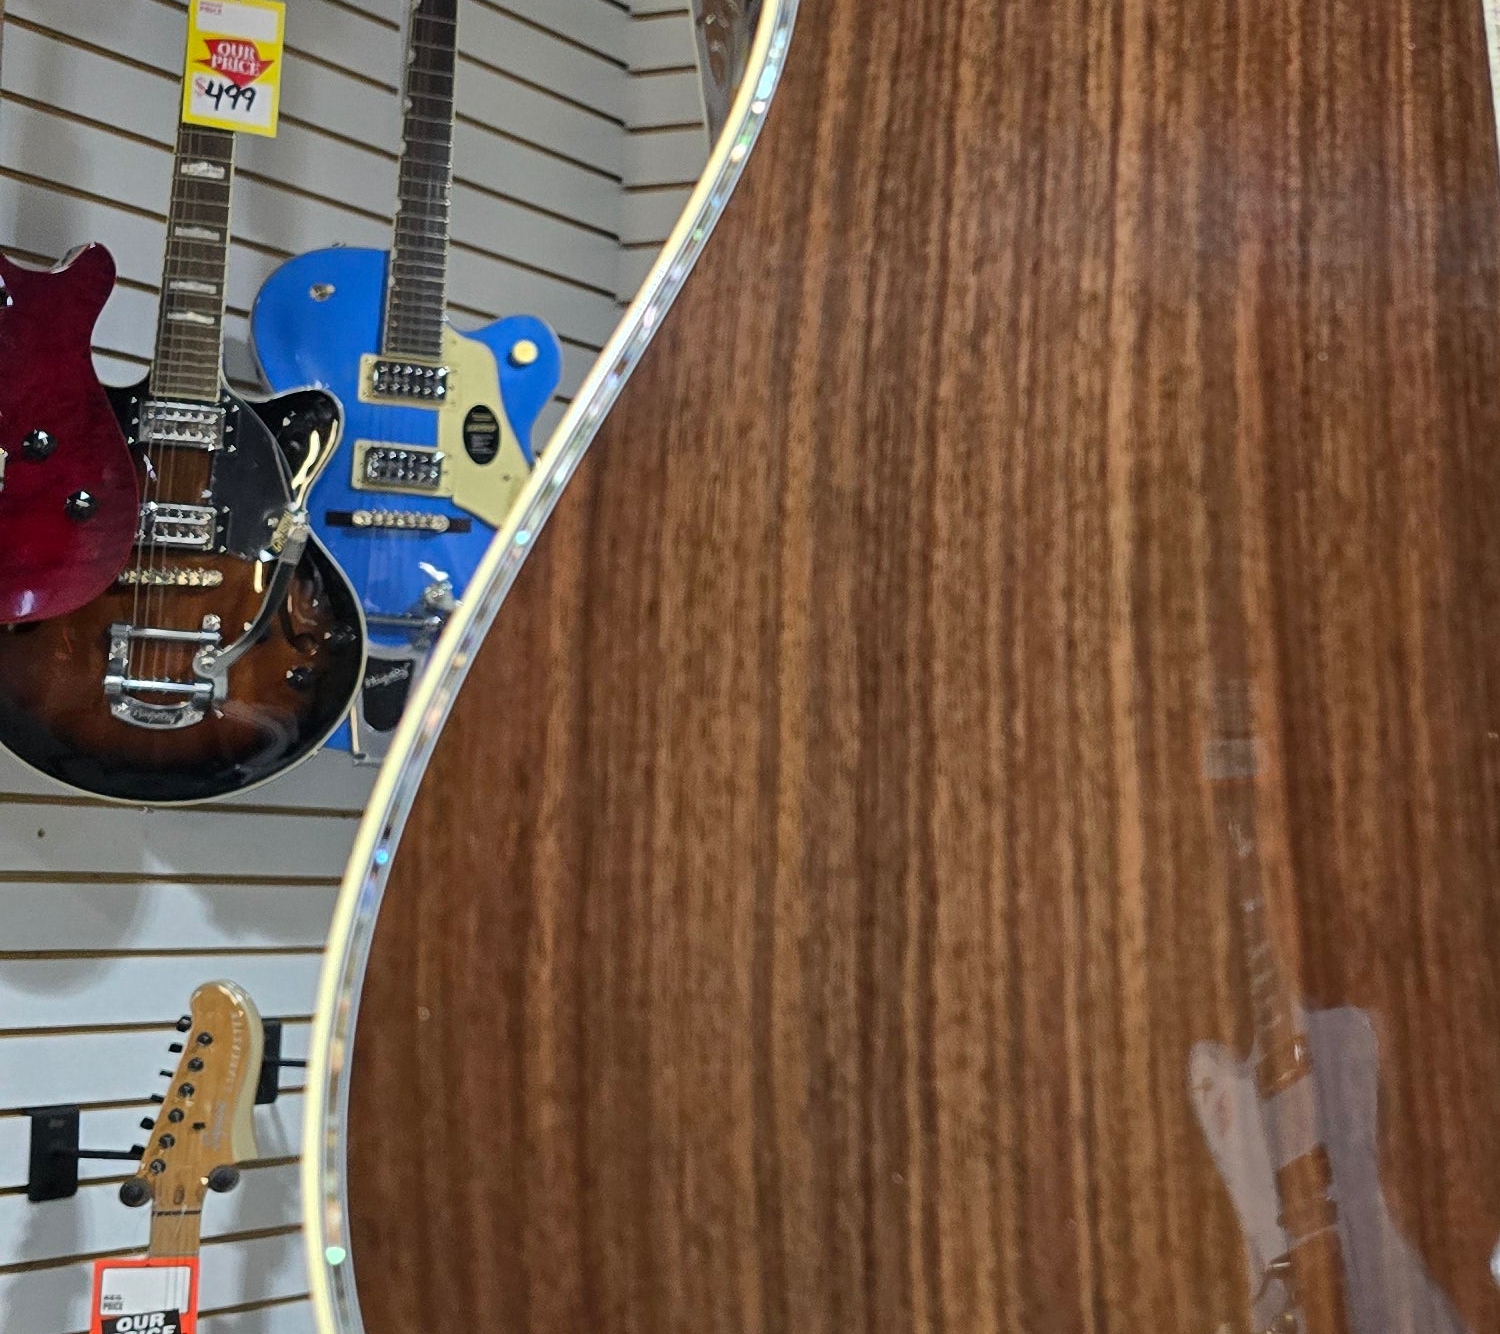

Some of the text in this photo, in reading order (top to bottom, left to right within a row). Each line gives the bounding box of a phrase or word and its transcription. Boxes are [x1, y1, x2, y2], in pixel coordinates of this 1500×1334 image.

[217, 41, 256, 61] OUR
[211, 54, 260, 77] PRICE
[195, 78, 256, 112] $499
[116, 1312, 166, 1333] OUR
